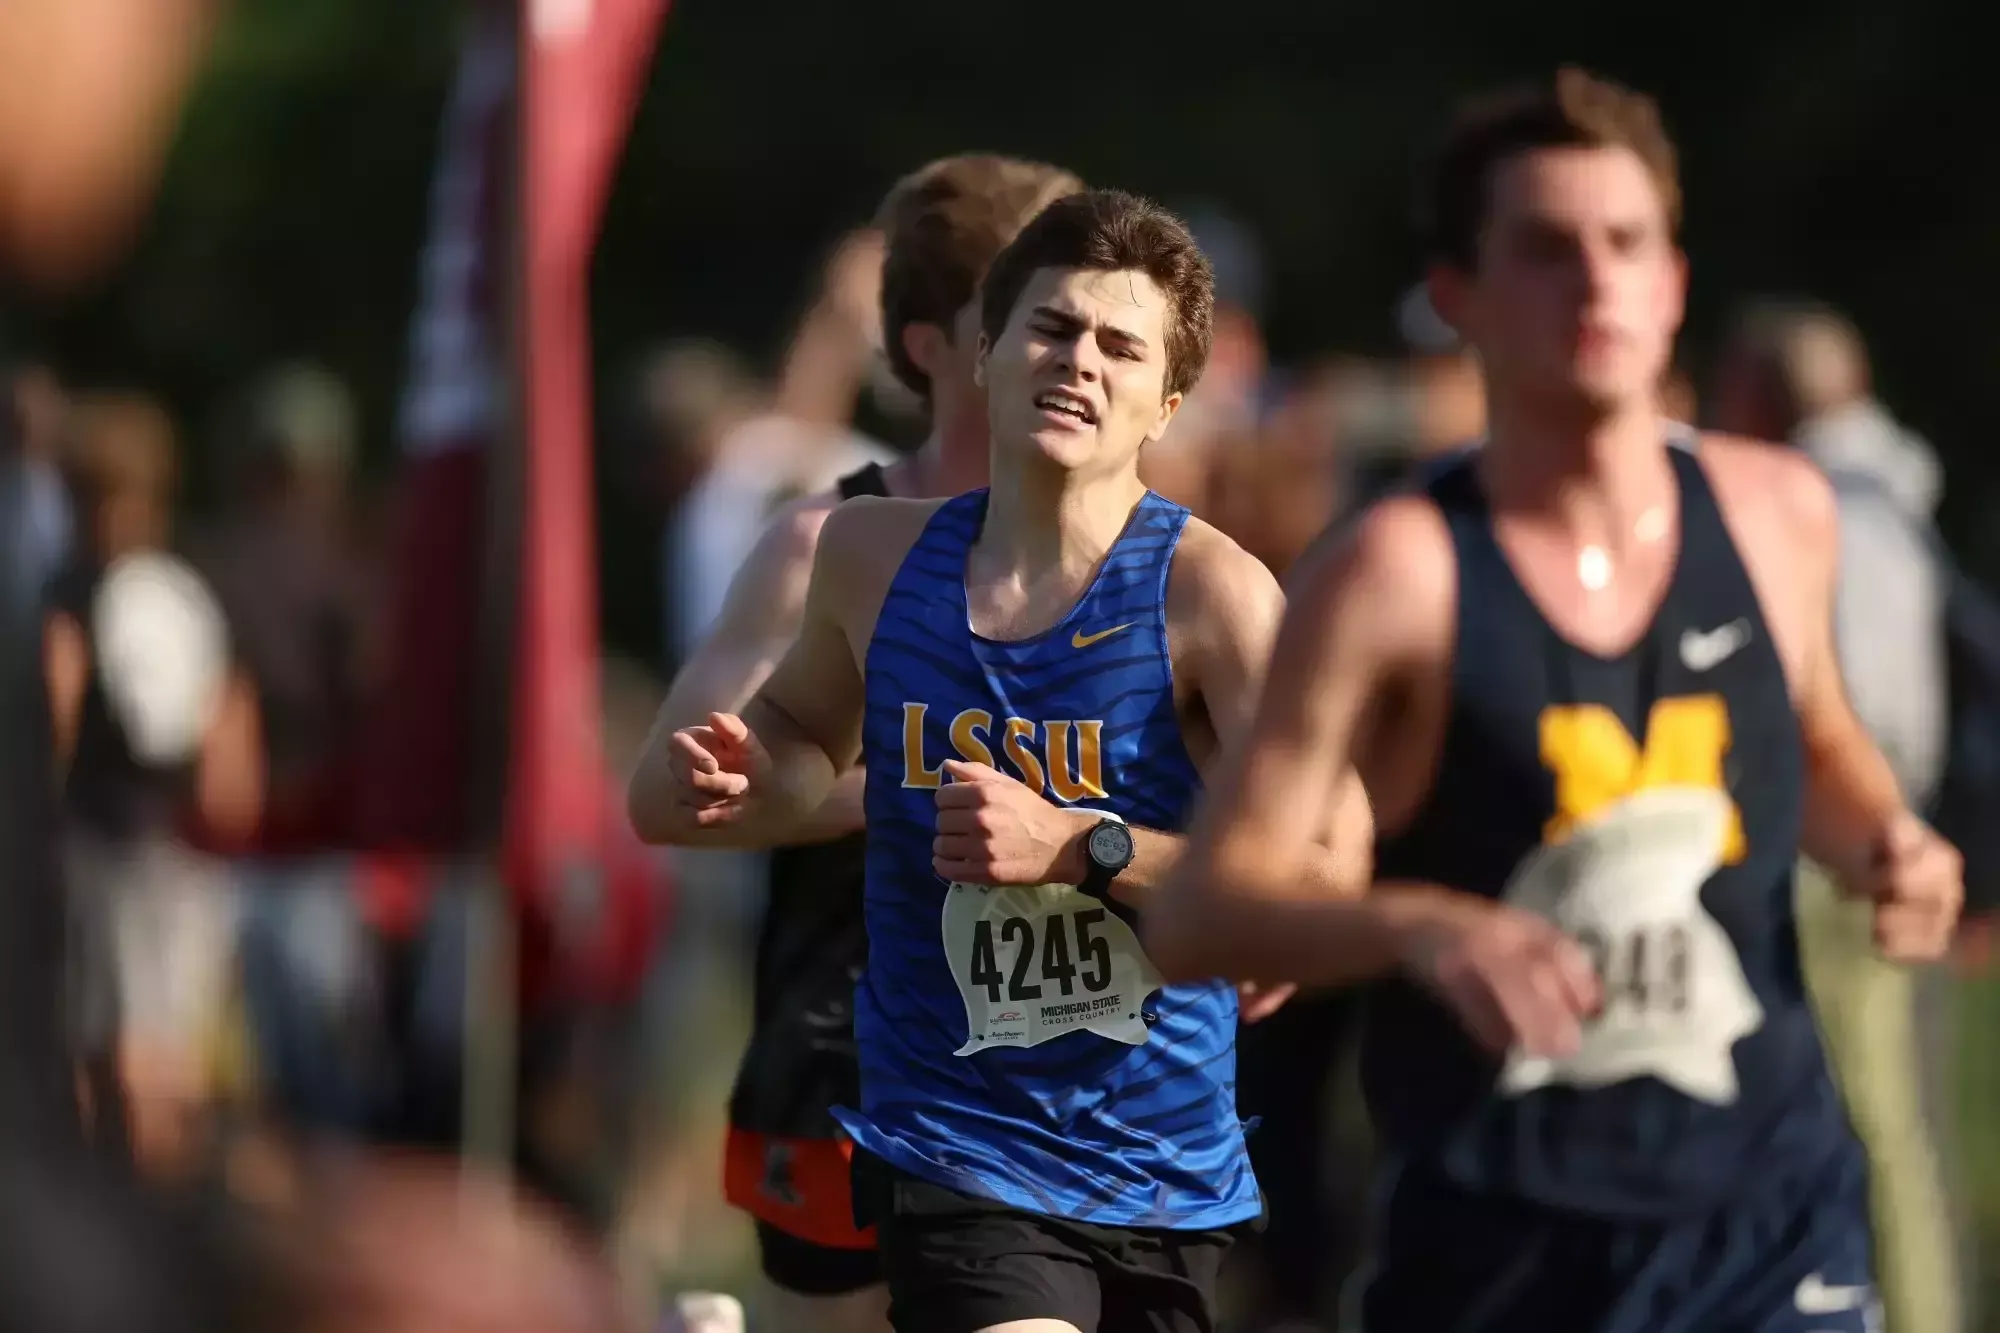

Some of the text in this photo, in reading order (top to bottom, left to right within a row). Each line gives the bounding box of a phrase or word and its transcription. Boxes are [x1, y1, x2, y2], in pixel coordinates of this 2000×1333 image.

[901, 702, 1110, 802] LSSU
[971, 908, 1112, 1002] 4245
[1041, 994, 1121, 1018] MICHIGAN STATE
[1042, 1006, 1121, 1026] CROSS COUNTRY
